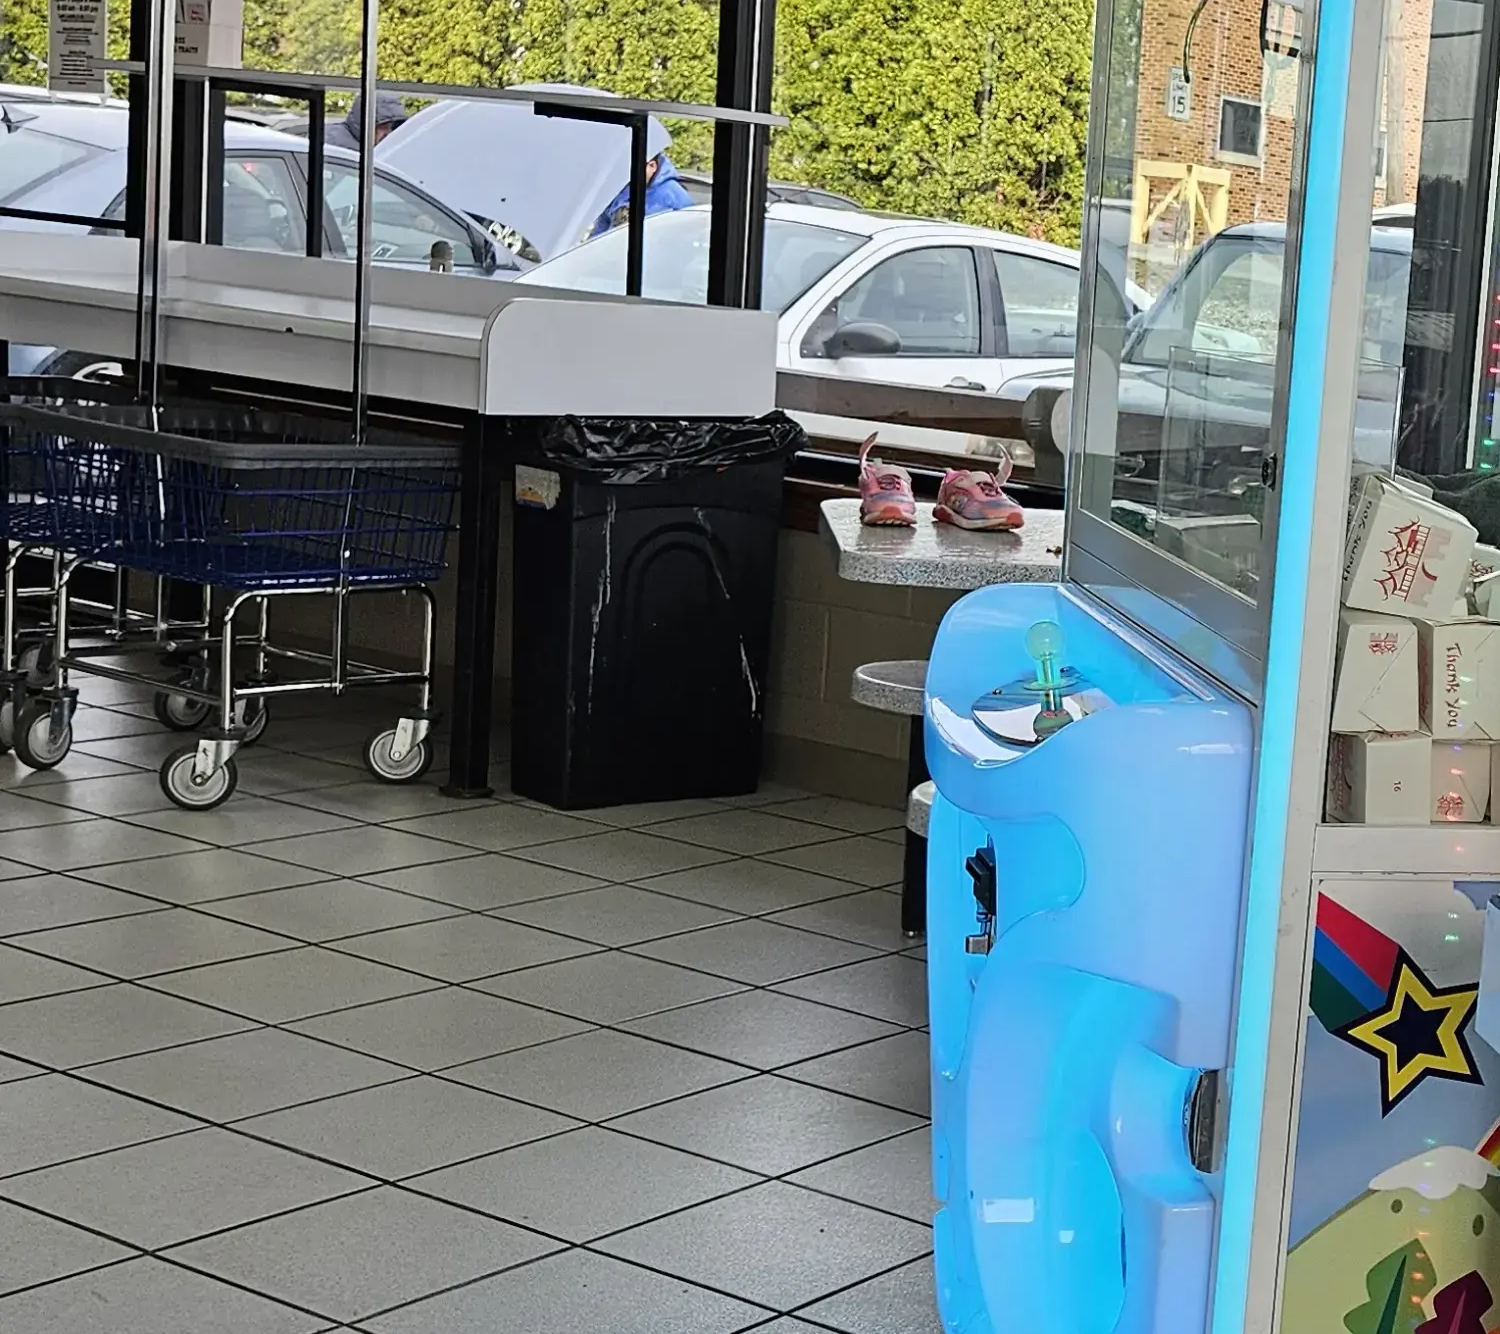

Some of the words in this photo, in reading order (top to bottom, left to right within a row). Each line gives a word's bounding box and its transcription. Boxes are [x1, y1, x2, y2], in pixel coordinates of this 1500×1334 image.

[1172, 95, 1186, 114] 15
[1445, 642, 1462, 694] Thank
[1445, 697, 1461, 727] You
